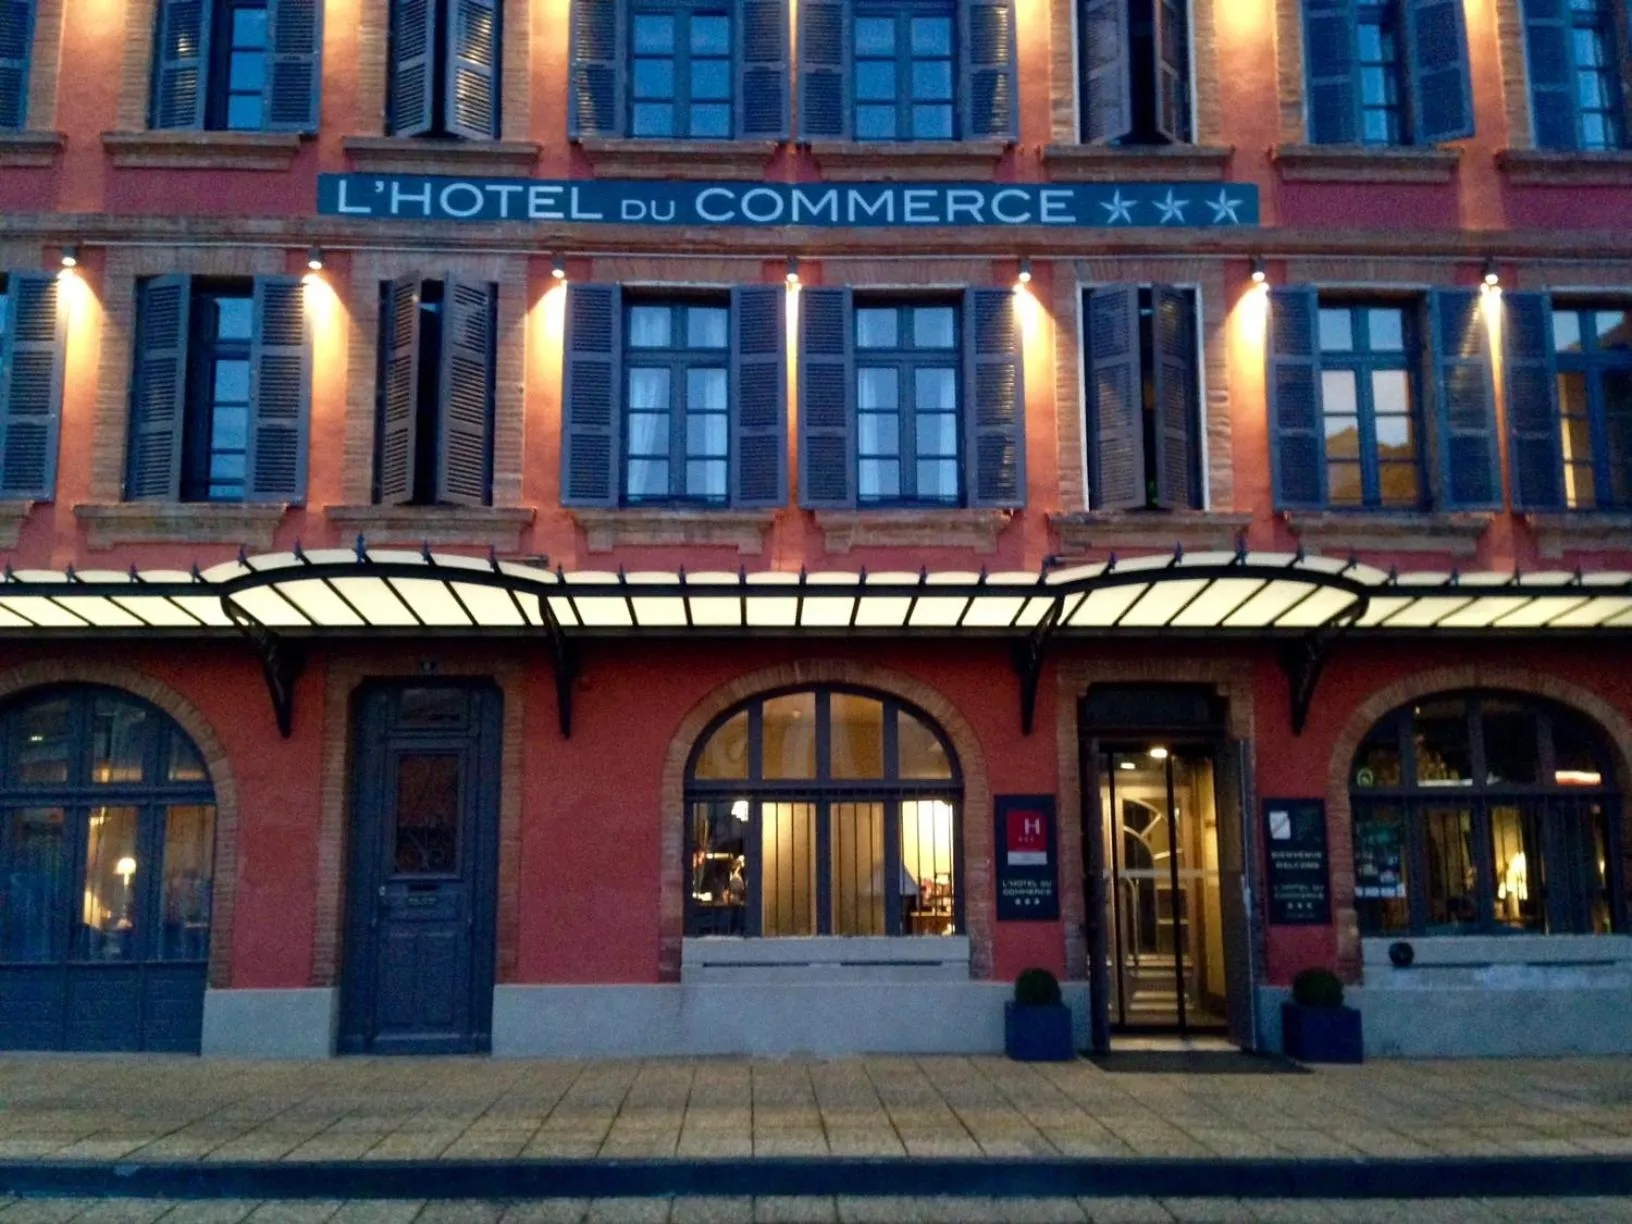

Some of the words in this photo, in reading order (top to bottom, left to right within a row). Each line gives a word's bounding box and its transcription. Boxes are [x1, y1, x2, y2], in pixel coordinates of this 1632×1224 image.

[337, 179, 604, 220] L'HOTEL
[620, 199, 676, 221] DU
[694, 187, 1077, 224] COMMERCE
[1023, 817, 1041, 835] H
